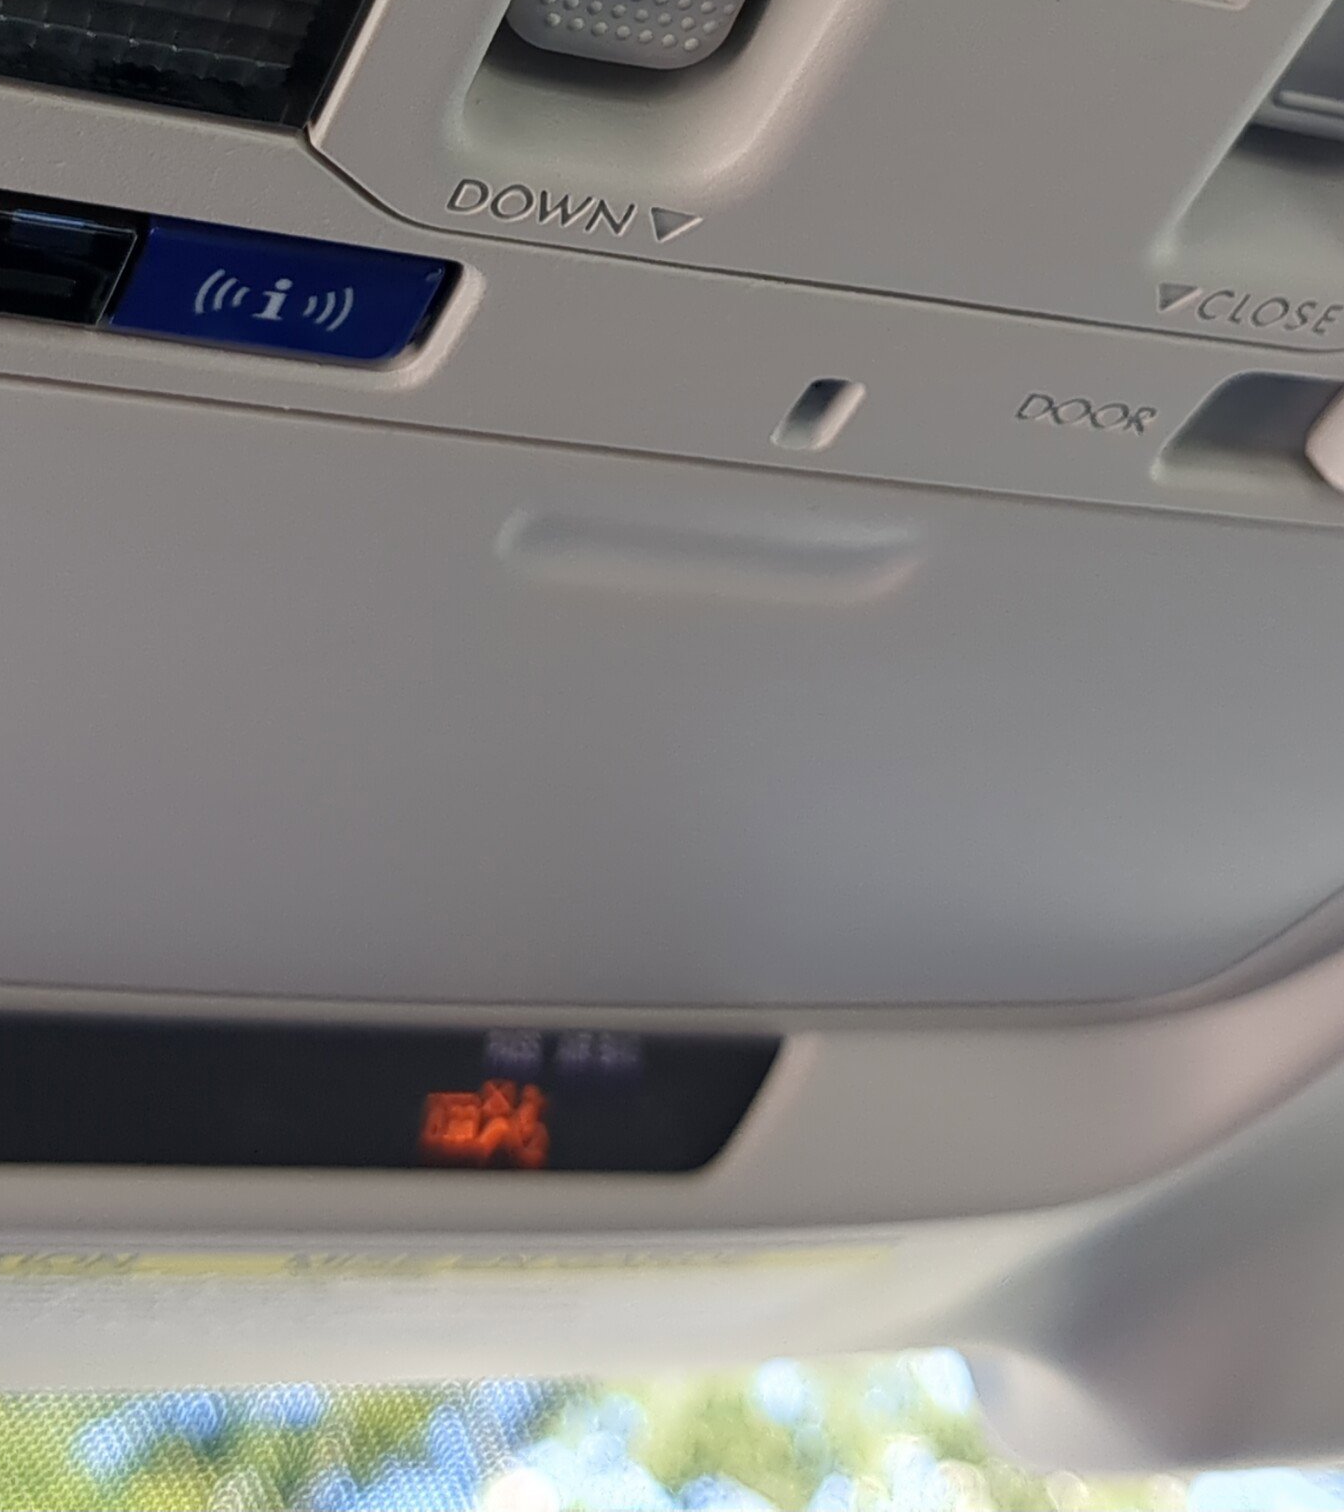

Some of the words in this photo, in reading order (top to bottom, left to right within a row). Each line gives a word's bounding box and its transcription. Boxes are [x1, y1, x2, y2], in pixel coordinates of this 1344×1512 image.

[446, 178, 637, 236] DOWN
[1196, 289, 1344, 336] CLOSE
[1015, 392, 1157, 435] DOOR
